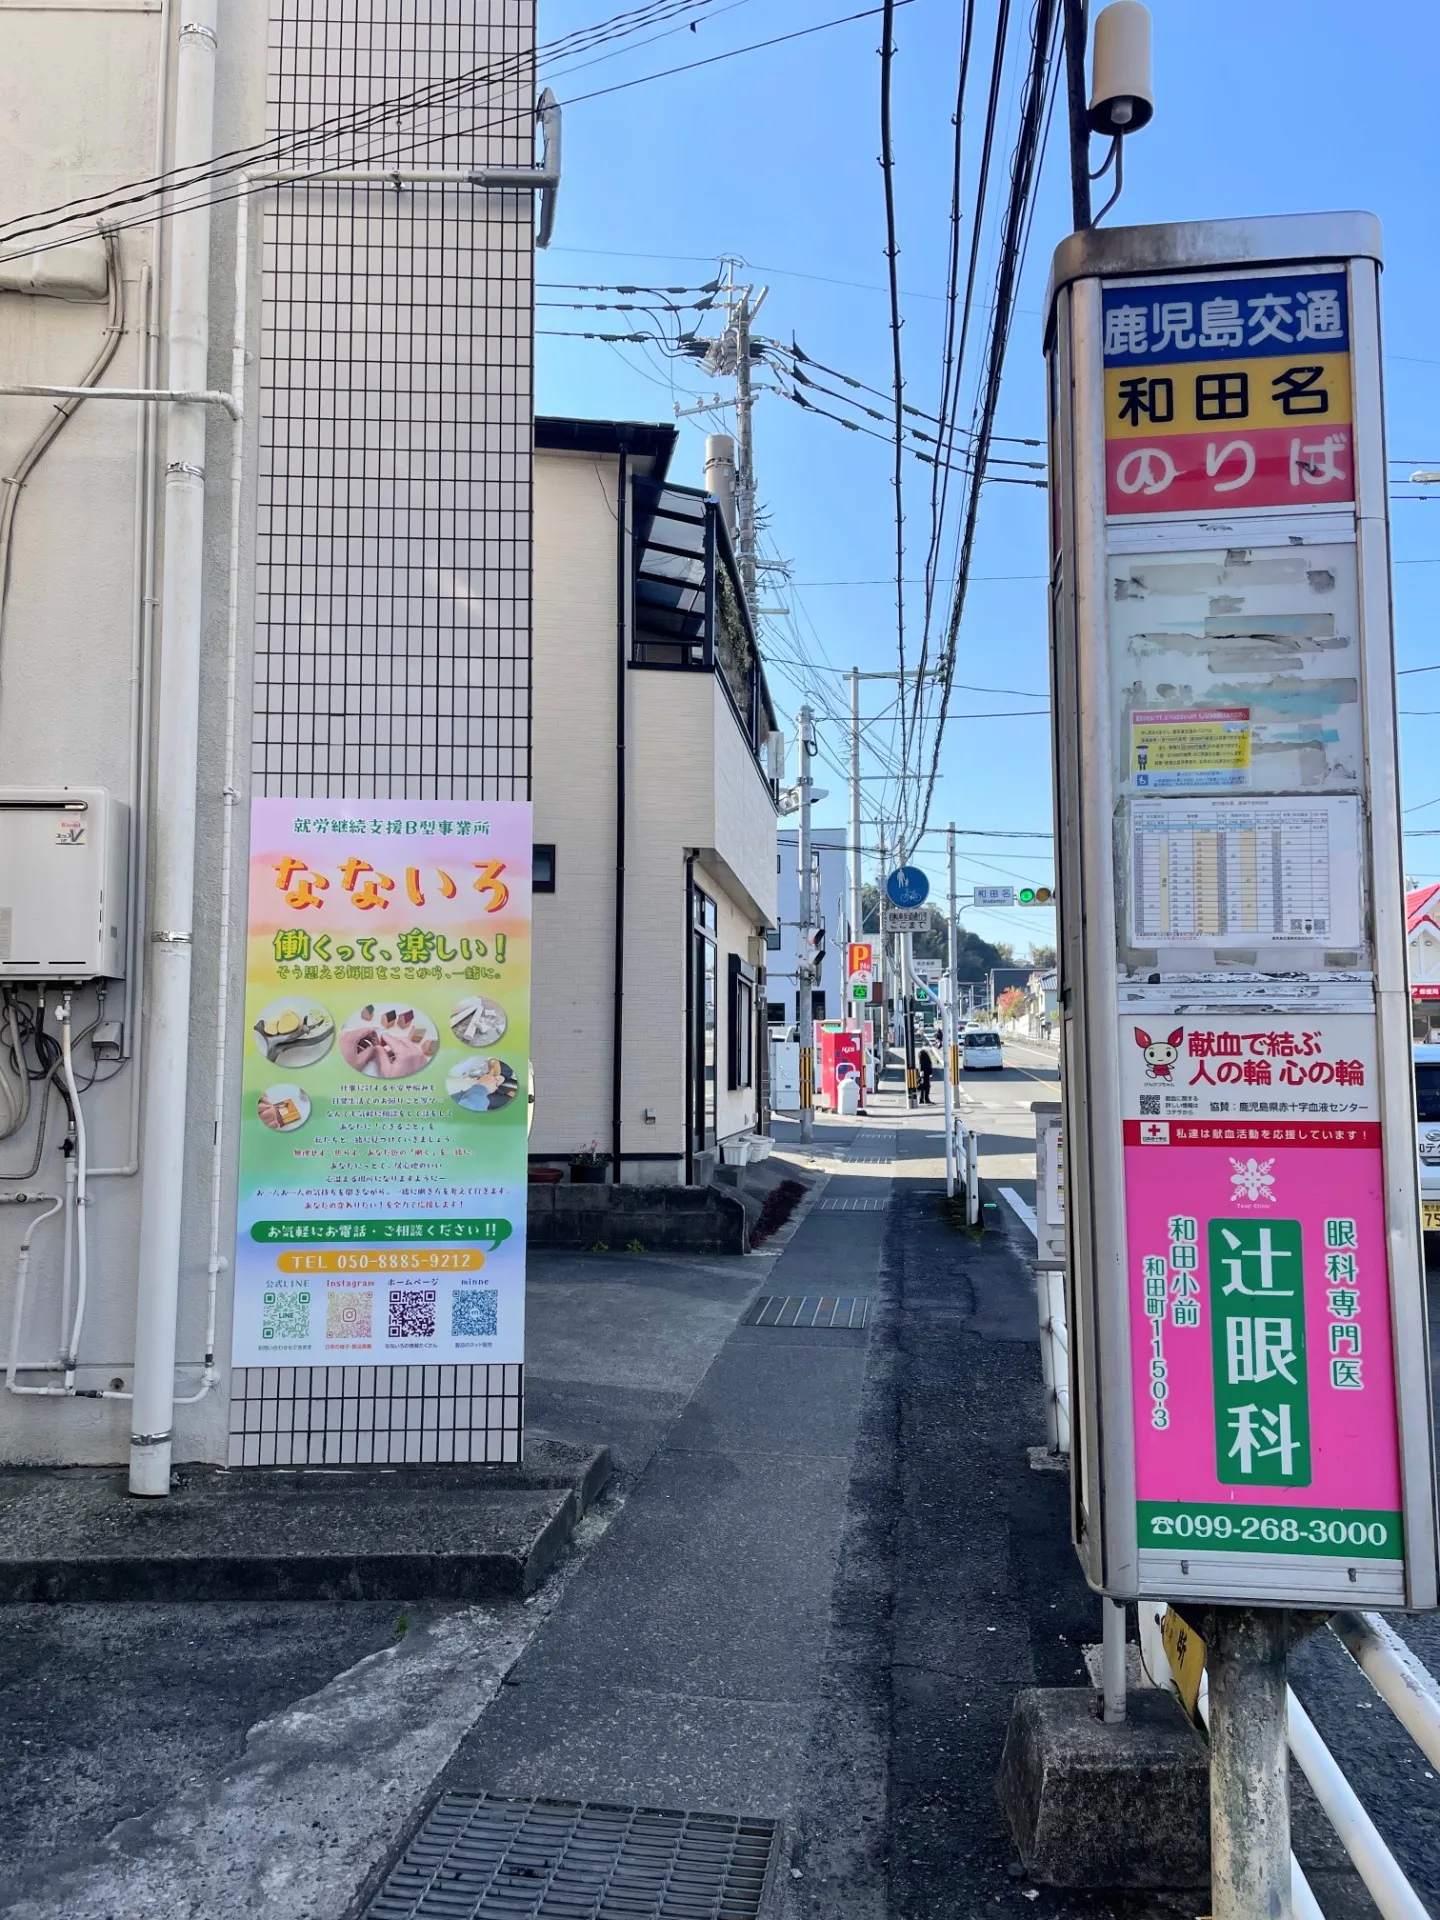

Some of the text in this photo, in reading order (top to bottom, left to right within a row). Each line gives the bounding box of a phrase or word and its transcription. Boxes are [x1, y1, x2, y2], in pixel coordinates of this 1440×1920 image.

[1104, 289, 1344, 355] 鹿児島交通
[1118, 366, 1328, 427] 和田名
[1116, 433, 1347, 495] のりば
[293, 818, 491, 836] 就労継続支援B型事業所
[272, 856, 509, 913] なないろ
[978, 889, 1010, 898] 和田名
[890, 921, 926, 929] ここまで
[853, 945, 869, 971] P
[276, 965, 501, 980] そう思える毎日をここから、一緒に。
[1187, 1031, 1322, 1057] 献血で結ぶ
[1188, 1059, 1365, 1086] 人の輪 心の輪
[1209, 1102, 1368, 1113] 協賛：鹿児島県赤十字血液センター
[292, 1253, 471, 1269] TEL 050-8885-9212
[1171, 1217, 1199, 1325] 和田小前
[265, 1279, 310, 1288] 公式LINE
[326, 1279, 375, 1288] Instagram
[387, 1278, 439, 1287] ホームページ
[461, 1278, 489, 1286] minne
[1327, 1220, 1362, 1388] 眼科専門医
[1221, 1228, 1301, 1475] 辻眼科
[1175, 1514, 1388, 1546] 099-268-3000
